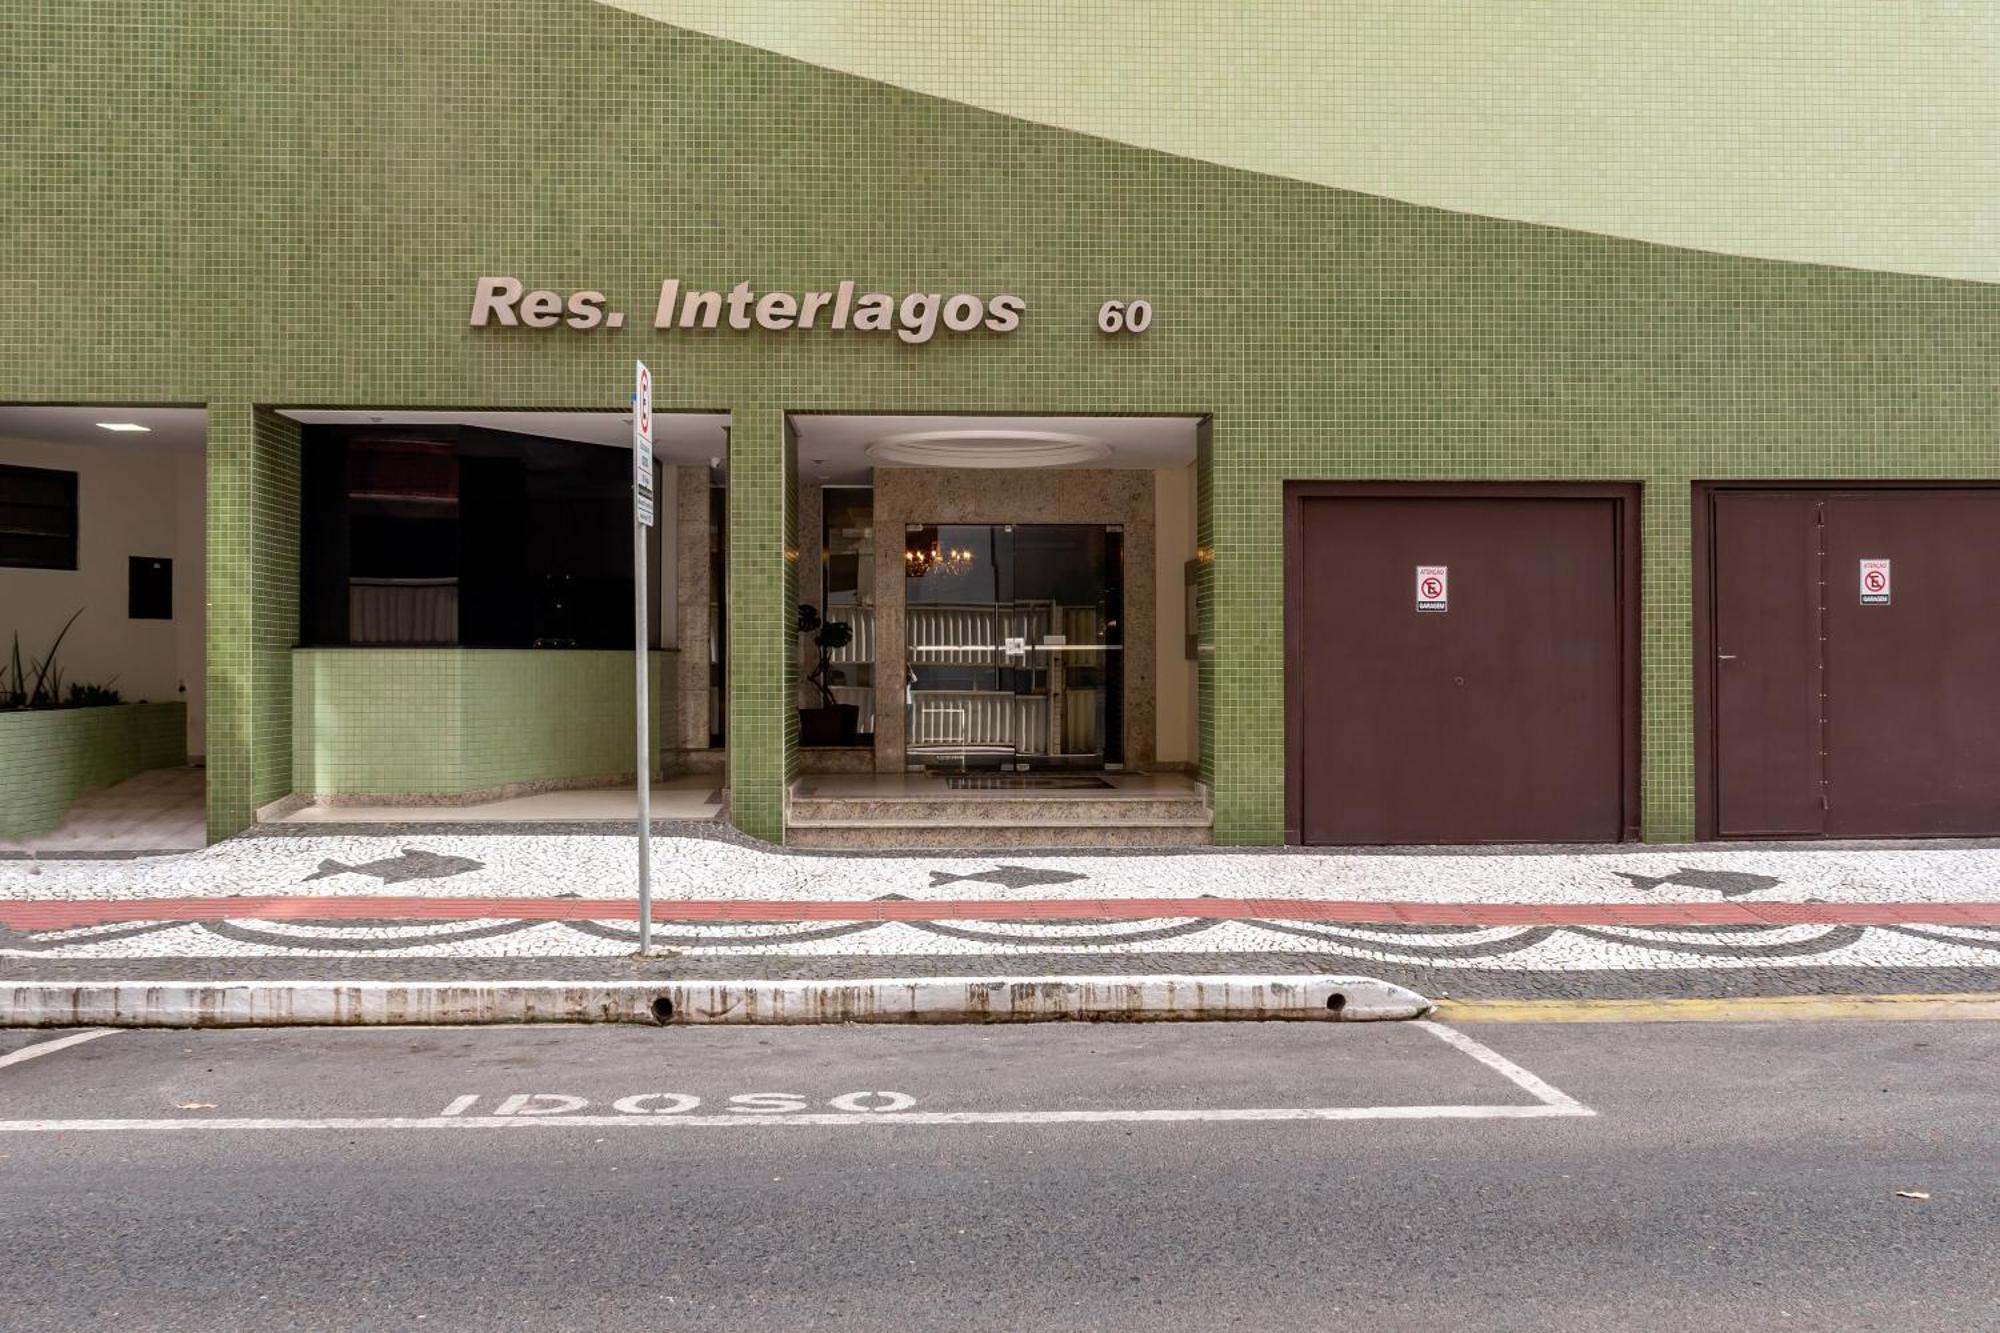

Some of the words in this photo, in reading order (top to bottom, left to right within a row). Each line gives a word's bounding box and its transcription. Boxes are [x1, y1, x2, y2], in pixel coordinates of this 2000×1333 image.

[470, 276, 625, 329] Res.
[654, 279, 1026, 343] Interlagos
[1098, 300, 1152, 333] 60
[440, 1091, 917, 1116] IDOSO
